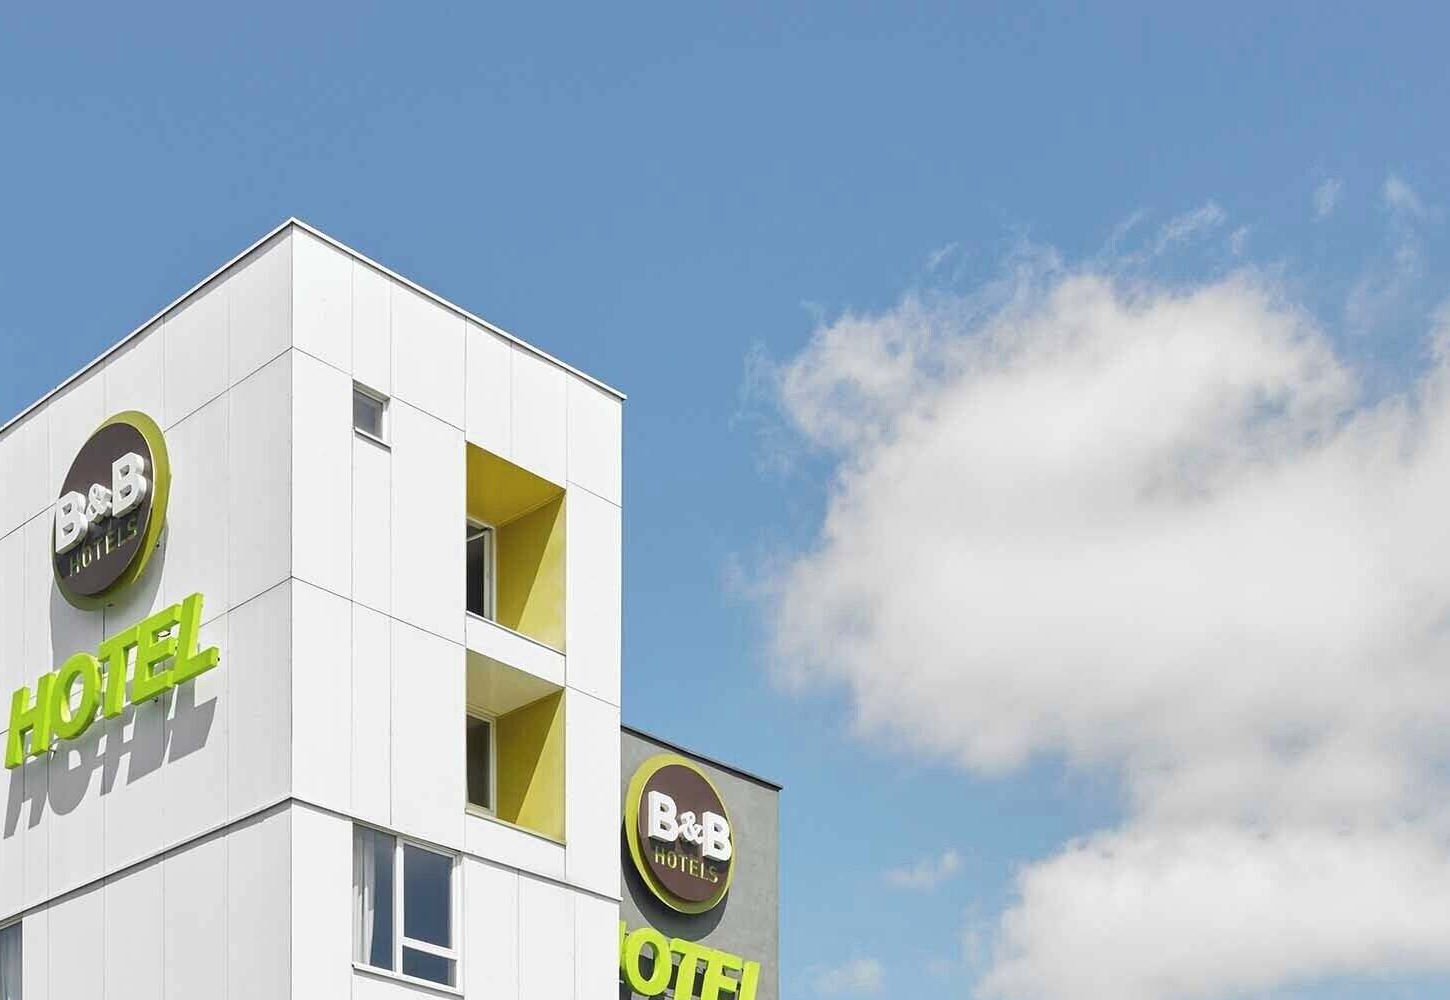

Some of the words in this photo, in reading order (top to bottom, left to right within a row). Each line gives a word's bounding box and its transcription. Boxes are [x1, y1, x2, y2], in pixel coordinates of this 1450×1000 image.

[55, 451, 147, 554] B&B
[69, 517, 138, 577] HOTELS
[5, 593, 220, 770] HOTEL
[648, 790, 733, 861] B&B
[655, 845, 719, 884] HOTELS
